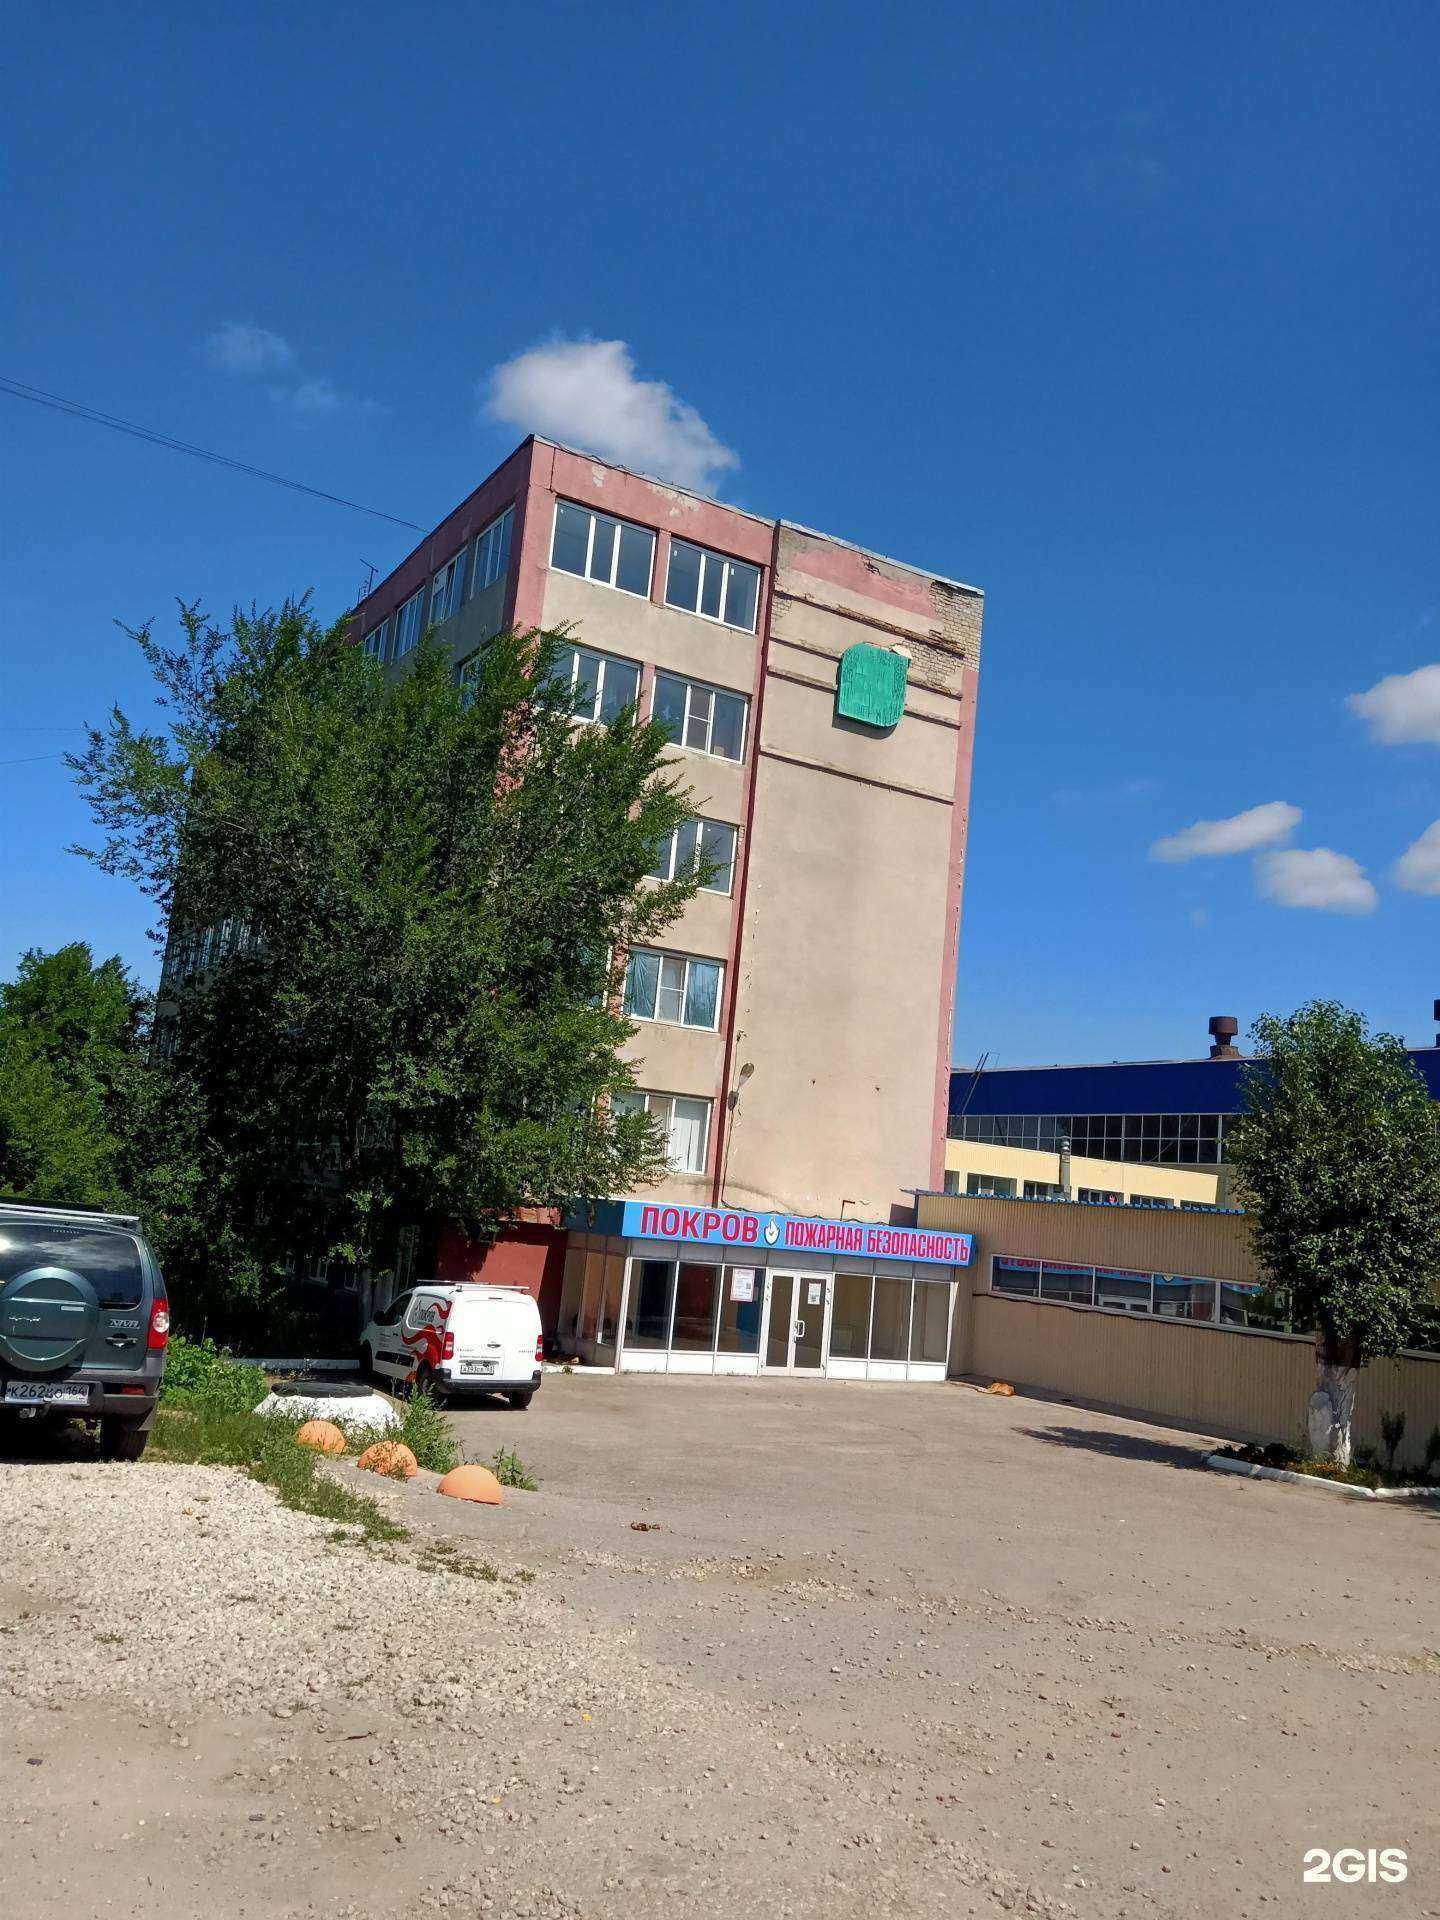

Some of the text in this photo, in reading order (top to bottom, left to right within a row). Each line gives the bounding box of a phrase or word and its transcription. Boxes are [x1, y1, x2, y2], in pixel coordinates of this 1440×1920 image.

[640, 1206, 968, 1262] ПОКРОВ ПОЖАРНАЯ БЕЗОПАСНОСТЬ
